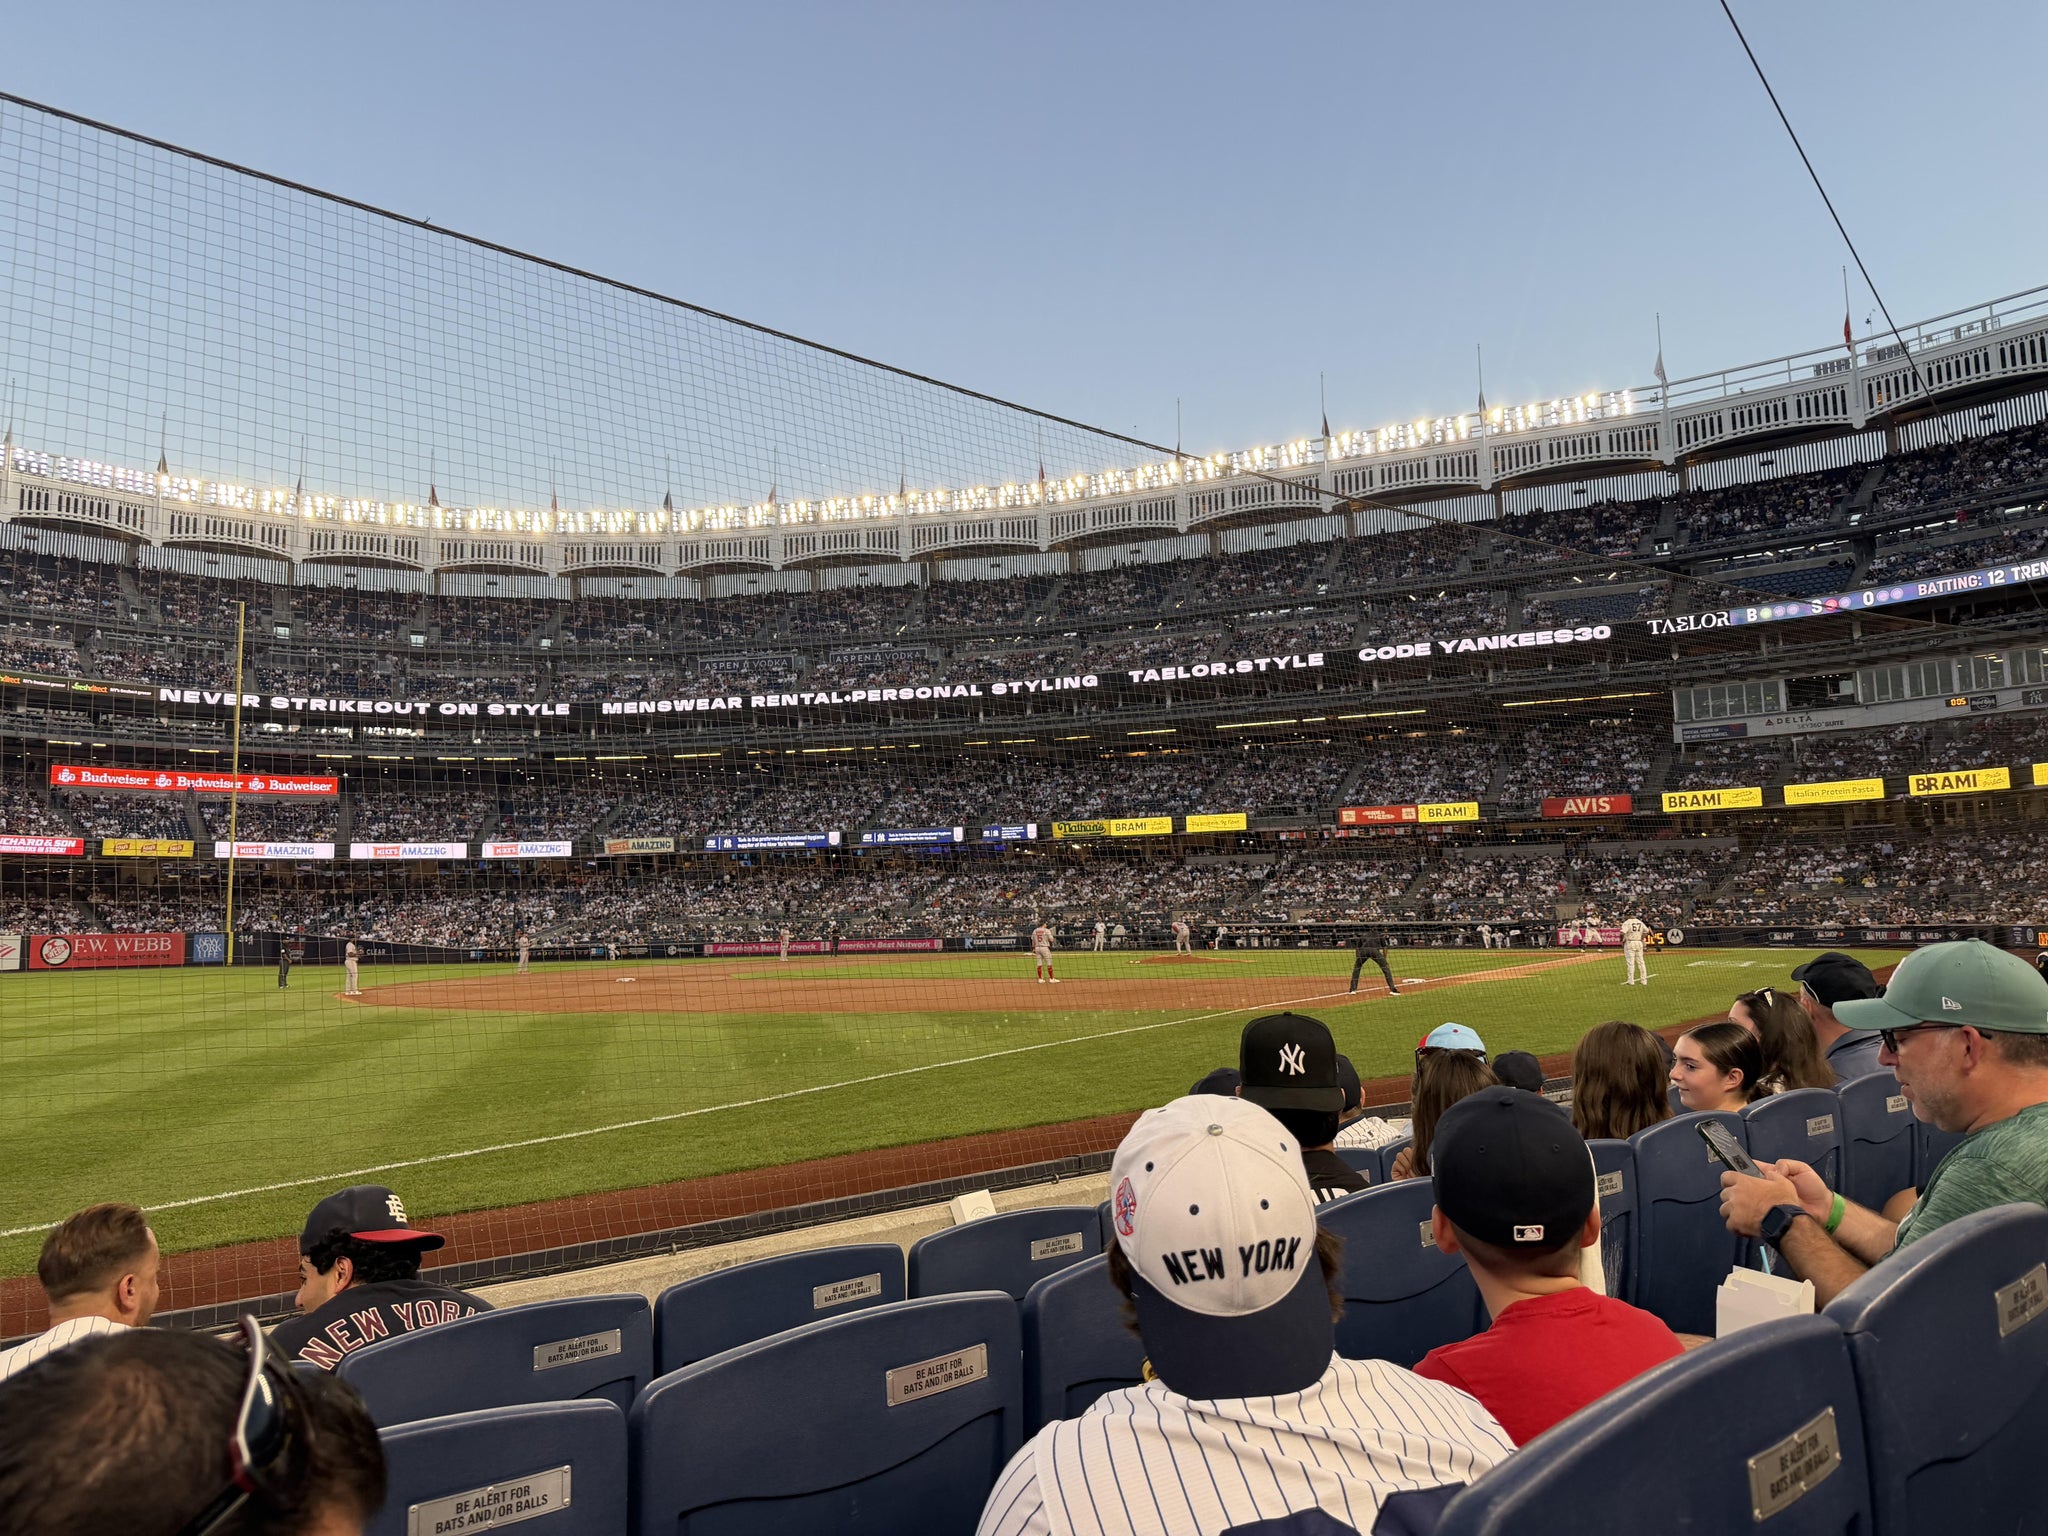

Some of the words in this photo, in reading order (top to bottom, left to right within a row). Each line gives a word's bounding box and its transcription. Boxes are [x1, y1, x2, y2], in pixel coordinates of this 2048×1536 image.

[1747, 608, 1758, 622] B
[1812, 599, 1823, 614] S
[1918, 575, 1982, 596] BATTING:
[1987, 570, 2006, 585] 12
[1358, 642, 1431, 662] CODE
[1437, 625, 1612, 654] YANKEES30
[836, 653, 871, 663] ASPEN
[885, 651, 921, 661] VODKA
[704, 660, 739, 671] ASPEN
[753, 658, 788, 669] VODKA
[602, 696, 742, 714] MENSWEAR
[991, 674, 1098, 696] STYLING
[160, 688, 260, 708] NEVER
[270, 696, 431, 715] STRIKEOUT
[439, 703, 478, 715] ON
[487, 703, 570, 716] STYLE
[1776, 715, 1812, 725] DELTA
[81, 770, 150, 786] Budweiser
[177, 776, 244, 789] Budweiser
[270, 779, 332, 792] Budweiser
[1916, 773, 1978, 792] BRAMI
[1794, 790, 1820, 798] Italian
[1822, 787, 1850, 796] Protein
[1852, 786, 1875, 794] Pasta
[1562, 797, 1610, 814] AVIS
[1668, 792, 1722, 808] BRAMI
[1428, 806, 1467, 818] BRAMI
[1058, 821, 1106, 834] Nathan's
[1115, 822, 1147, 832] BRAMI
[54, 839, 76, 848] SON
[520, 845, 562, 854] AMAZING
[632, 841, 672, 850] AMAZING
[266, 846, 314, 856] AMAZING
[401, 847, 447, 856] AMAZING
[1632, 922, 1641, 932] 67
[1782, 932, 1794, 940] APP
[1824, 930, 1838, 938] SHOP
[74, 938, 108, 953] F.W.
[114, 937, 172, 952] WEBB
[199, 937, 219, 946] NEW
[761, 942, 778, 951] Best
[838, 941, 876, 950] merica's
[878, 941, 895, 949] Best
[196, 944, 222, 952] YORK
[366, 948, 386, 956] CLEAR
[202, 951, 219, 960] LIFE
[1278, 1042, 1306, 1076] NY
[1162, 1248, 1224, 1285] NEW
[1238, 1237, 1302, 1278] YORK
[824, 1294, 836, 1302] BATS
[858, 1286, 872, 1294] BALLS
[832, 1286, 838, 1294] BE
[840, 1283, 854, 1292] ALERT
[298, 1307, 390, 1371] NEW
[568, 1340, 586, 1350] ALERT
[588, 1338, 598, 1347] FOR
[548, 1354, 564, 1362] BATS
[564, 1348, 590, 1360] AND/OR
[590, 1344, 608, 1354] BALLS
[916, 1368, 926, 1380] BE
[928, 1362, 948, 1376] ALERT
[950, 1358, 962, 1370] FOR
[904, 1381, 924, 1394] BATS
[924, 1372, 953, 1389] AND/OR
[954, 1365, 974, 1380] BALLS
[456, 1502, 470, 1514] BE
[474, 1490, 508, 1510] ALERT
[510, 1485, 531, 1500] FOR
[436, 1516, 465, 1534] BATS
[468, 1504, 513, 1526] AND/OR
[516, 1494, 548, 1513] BALLS
